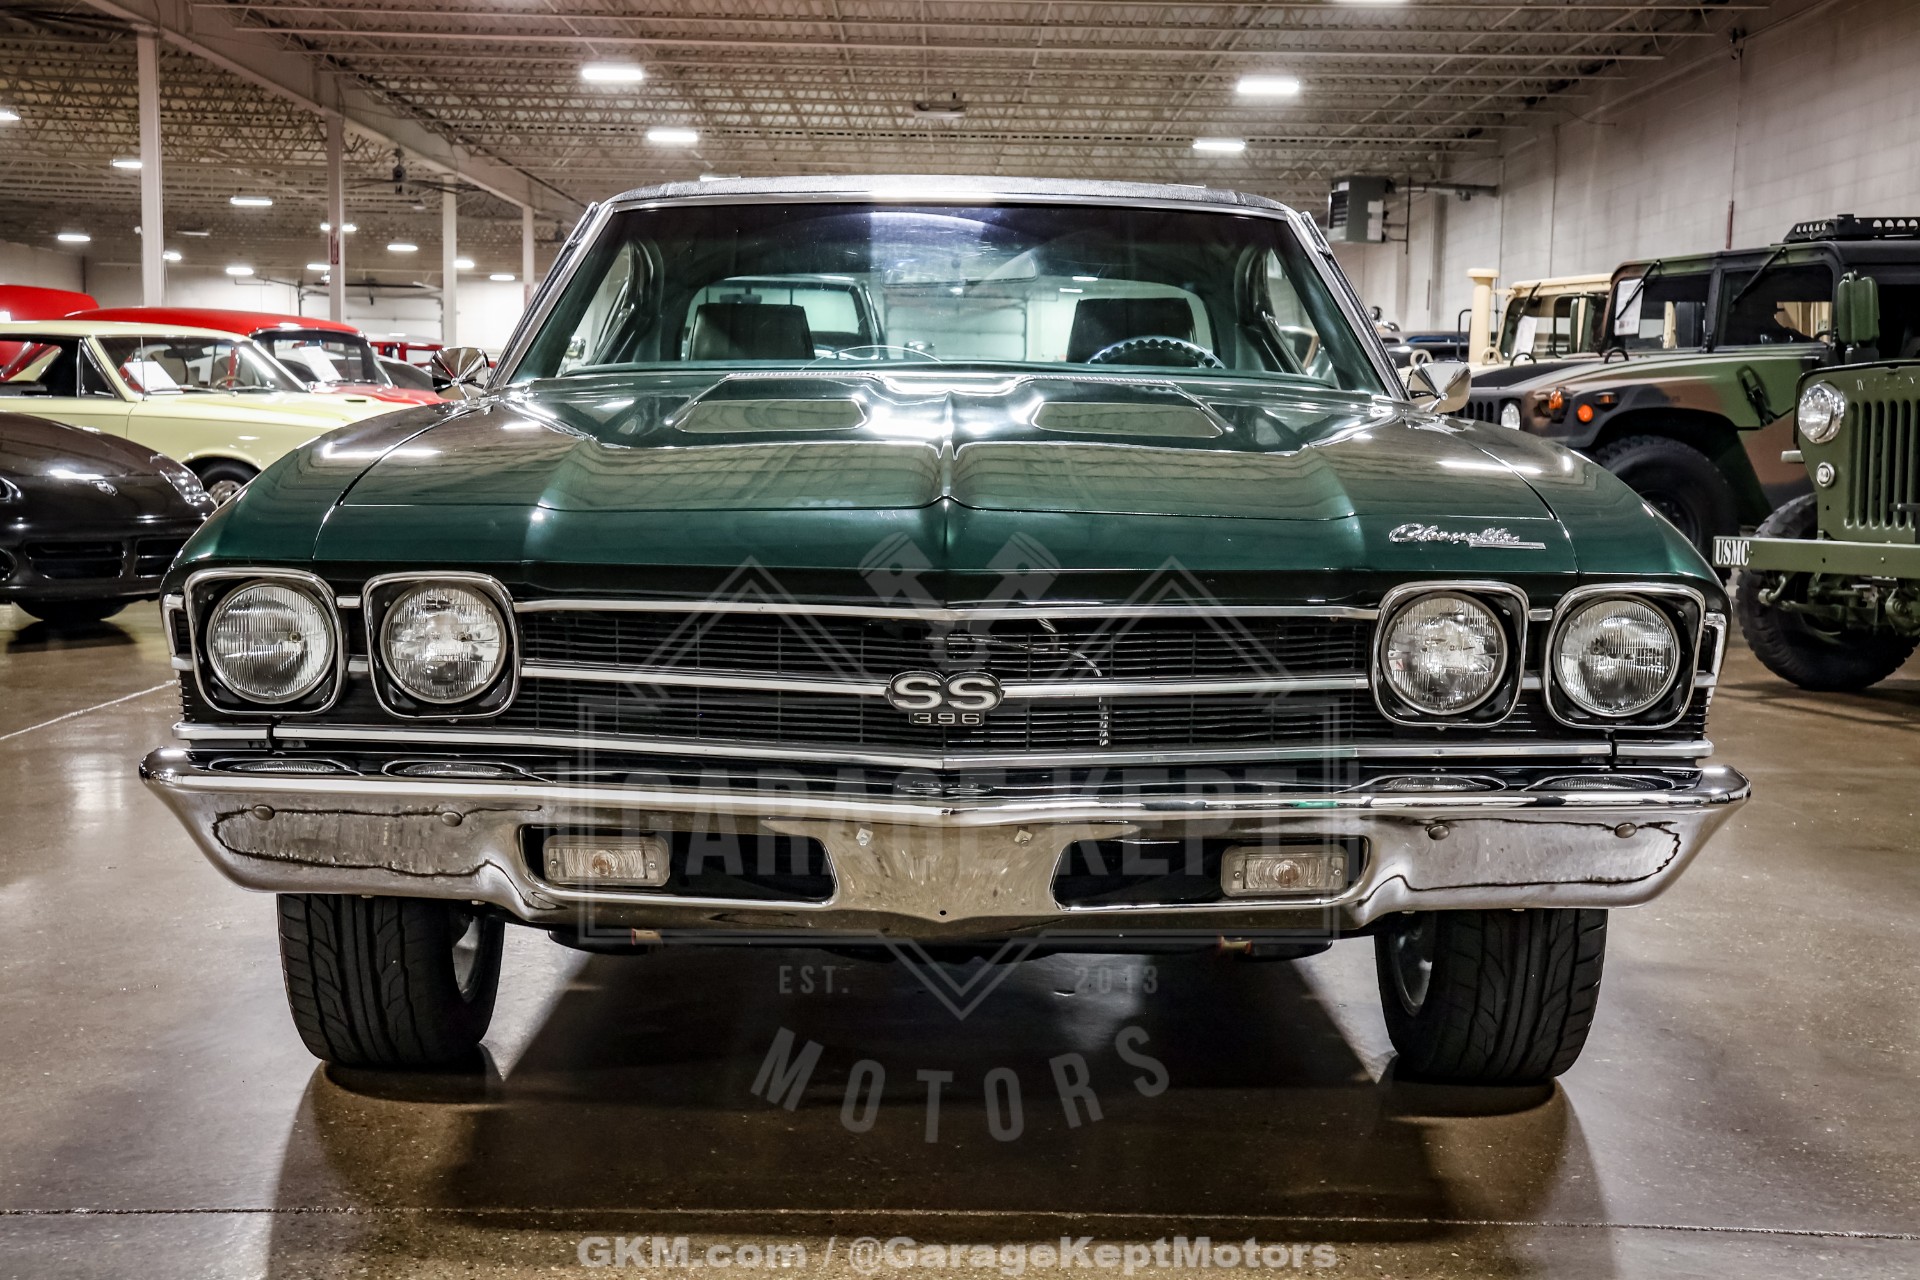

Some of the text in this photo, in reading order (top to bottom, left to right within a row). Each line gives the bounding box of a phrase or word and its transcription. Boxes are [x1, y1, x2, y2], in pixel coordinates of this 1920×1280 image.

[1715, 539, 1750, 567] USMC
[893, 676, 998, 710] SS
[913, 712, 981, 725] 396
